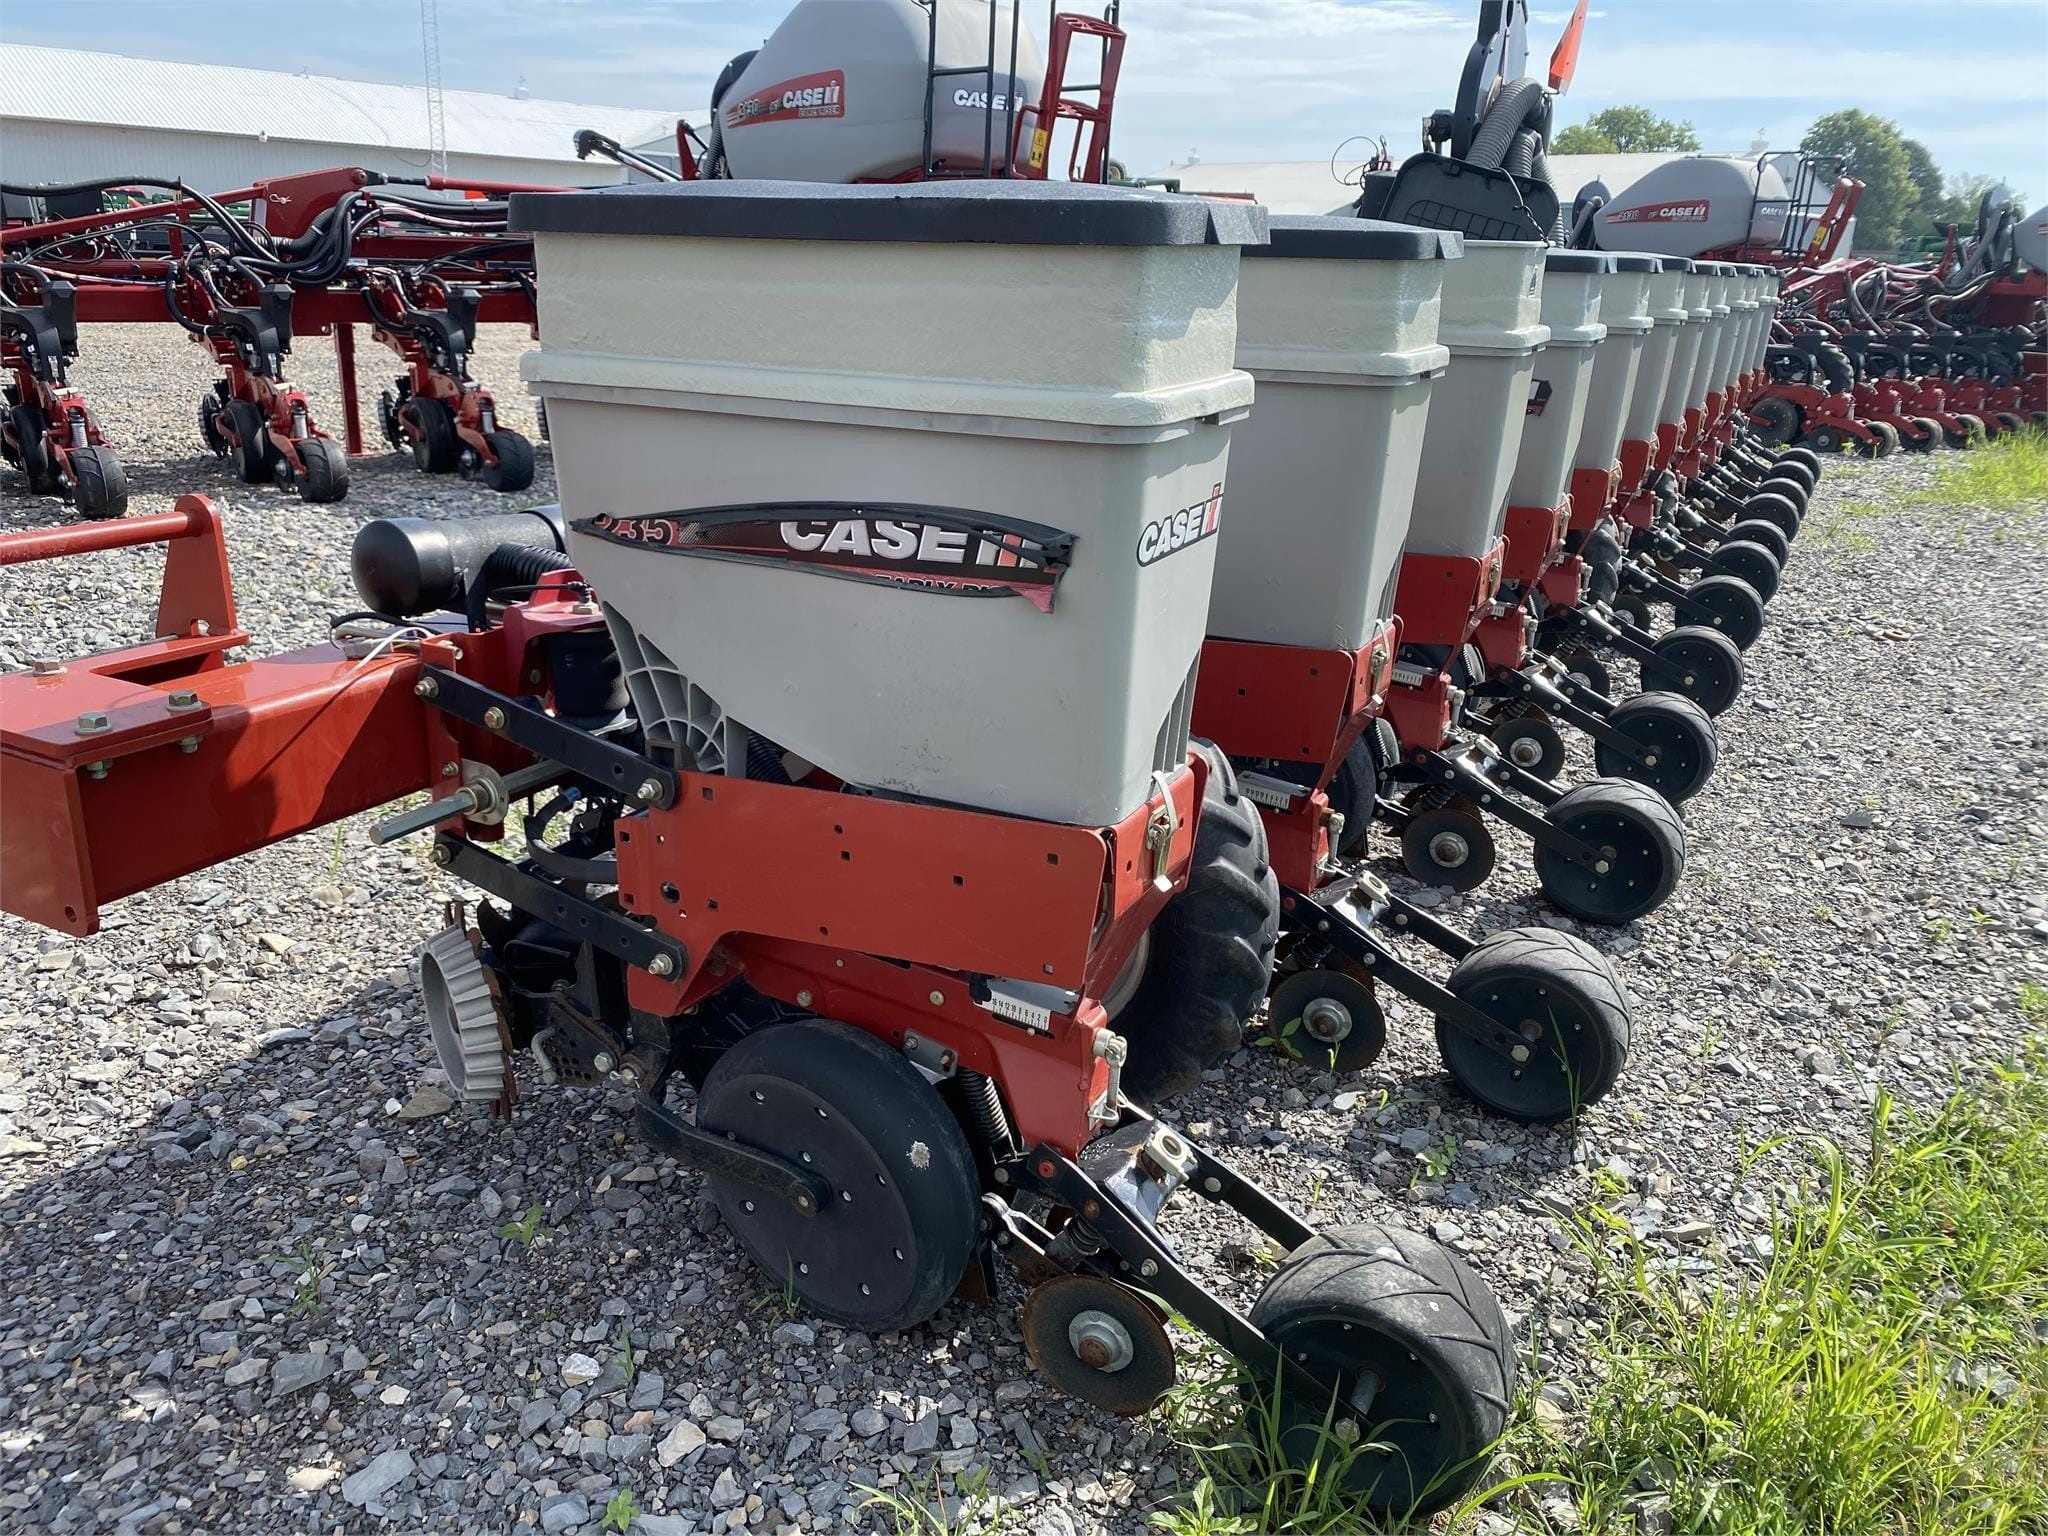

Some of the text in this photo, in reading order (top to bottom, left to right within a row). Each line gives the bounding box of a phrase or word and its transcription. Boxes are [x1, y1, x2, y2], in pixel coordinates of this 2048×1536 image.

[783, 87, 824, 109] CASE
[1660, 206, 1693, 217] CASE
[780, 518, 968, 564] CASE
[1137, 500, 1204, 565] CASE
